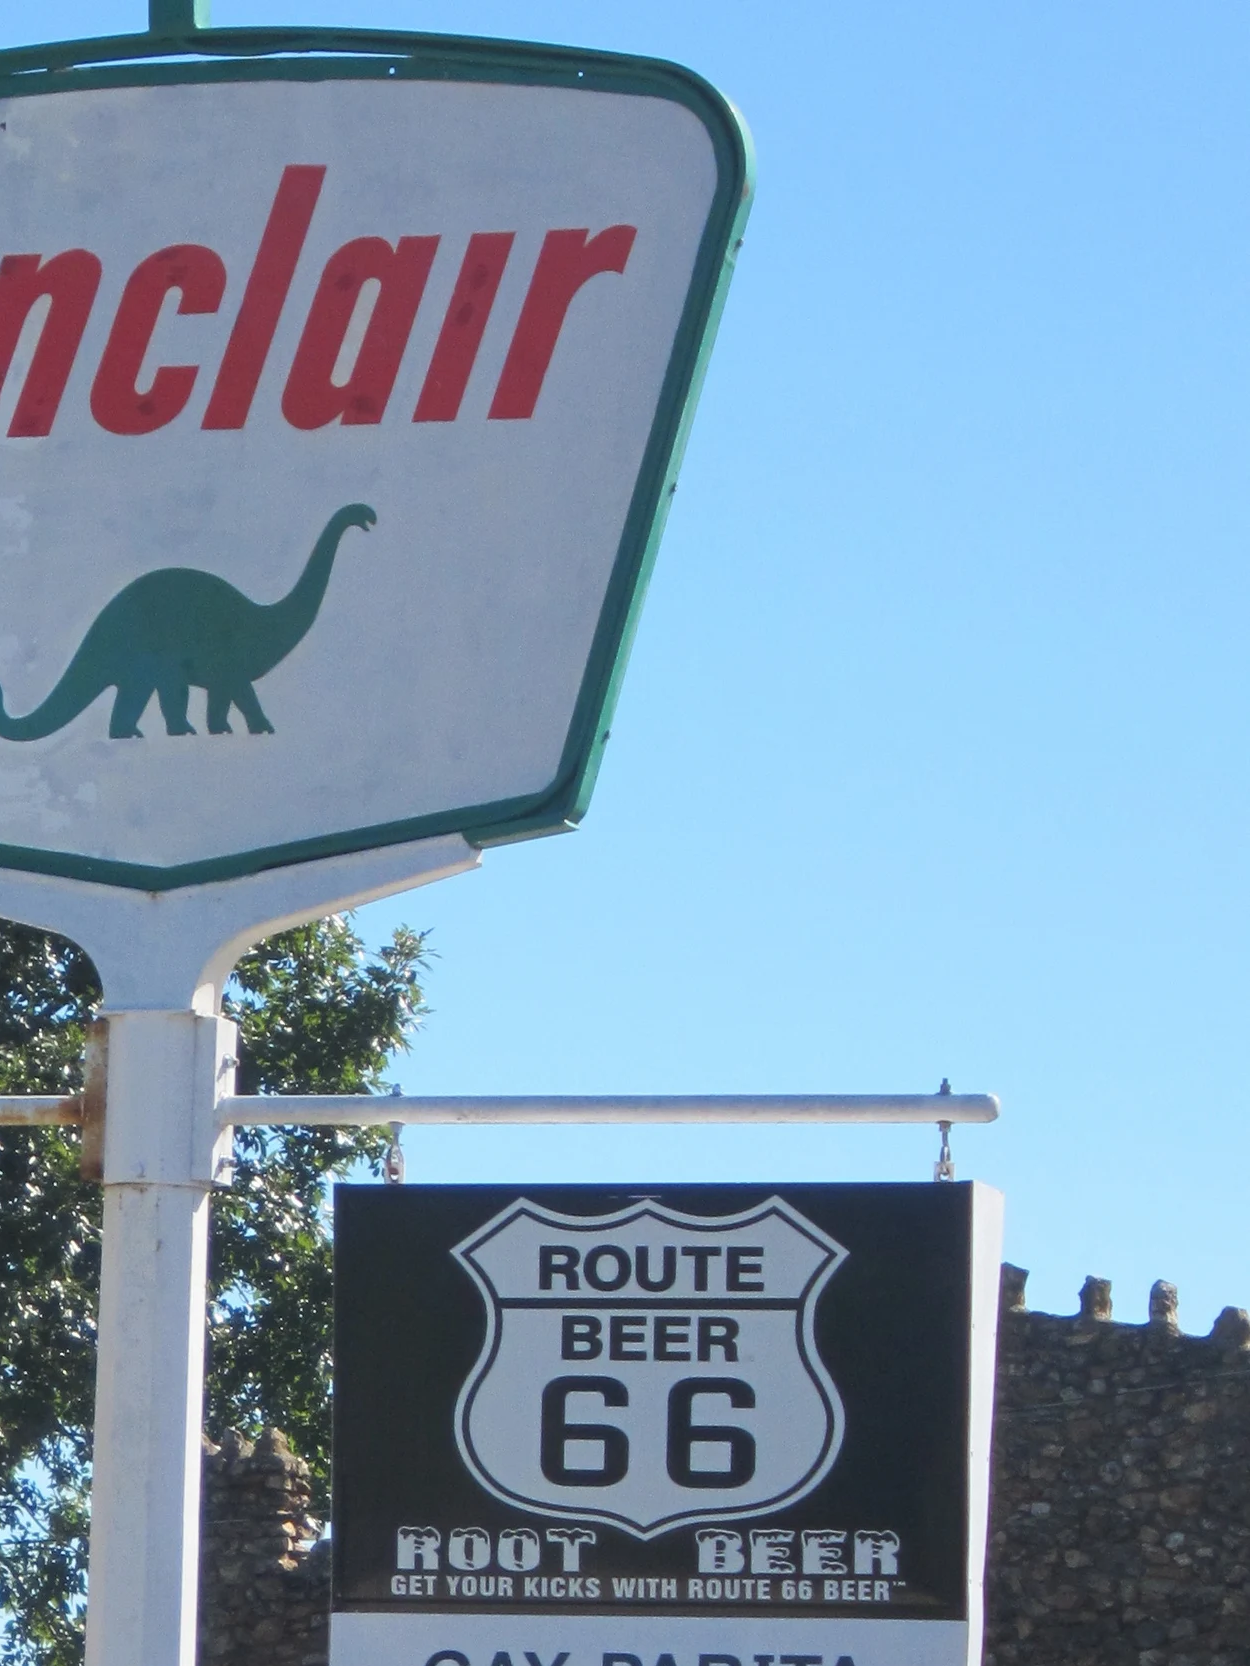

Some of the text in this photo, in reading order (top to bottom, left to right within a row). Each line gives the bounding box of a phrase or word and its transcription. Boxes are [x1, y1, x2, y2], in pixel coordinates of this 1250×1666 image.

[538, 1245, 765, 1291] ROUTE
[560, 1315, 739, 1362] BEER
[539, 1375, 756, 1489] 66
[396, 1526, 900, 1576] ROOT BEER
[390, 1575, 438, 1597] GET
[446, 1576, 514, 1598] YOUR
[524, 1576, 601, 1599] KICKS
[611, 1577, 678, 1599] WITH
[687, 1579, 771, 1601] ROUTE
[781, 1579, 812, 1601] 66
